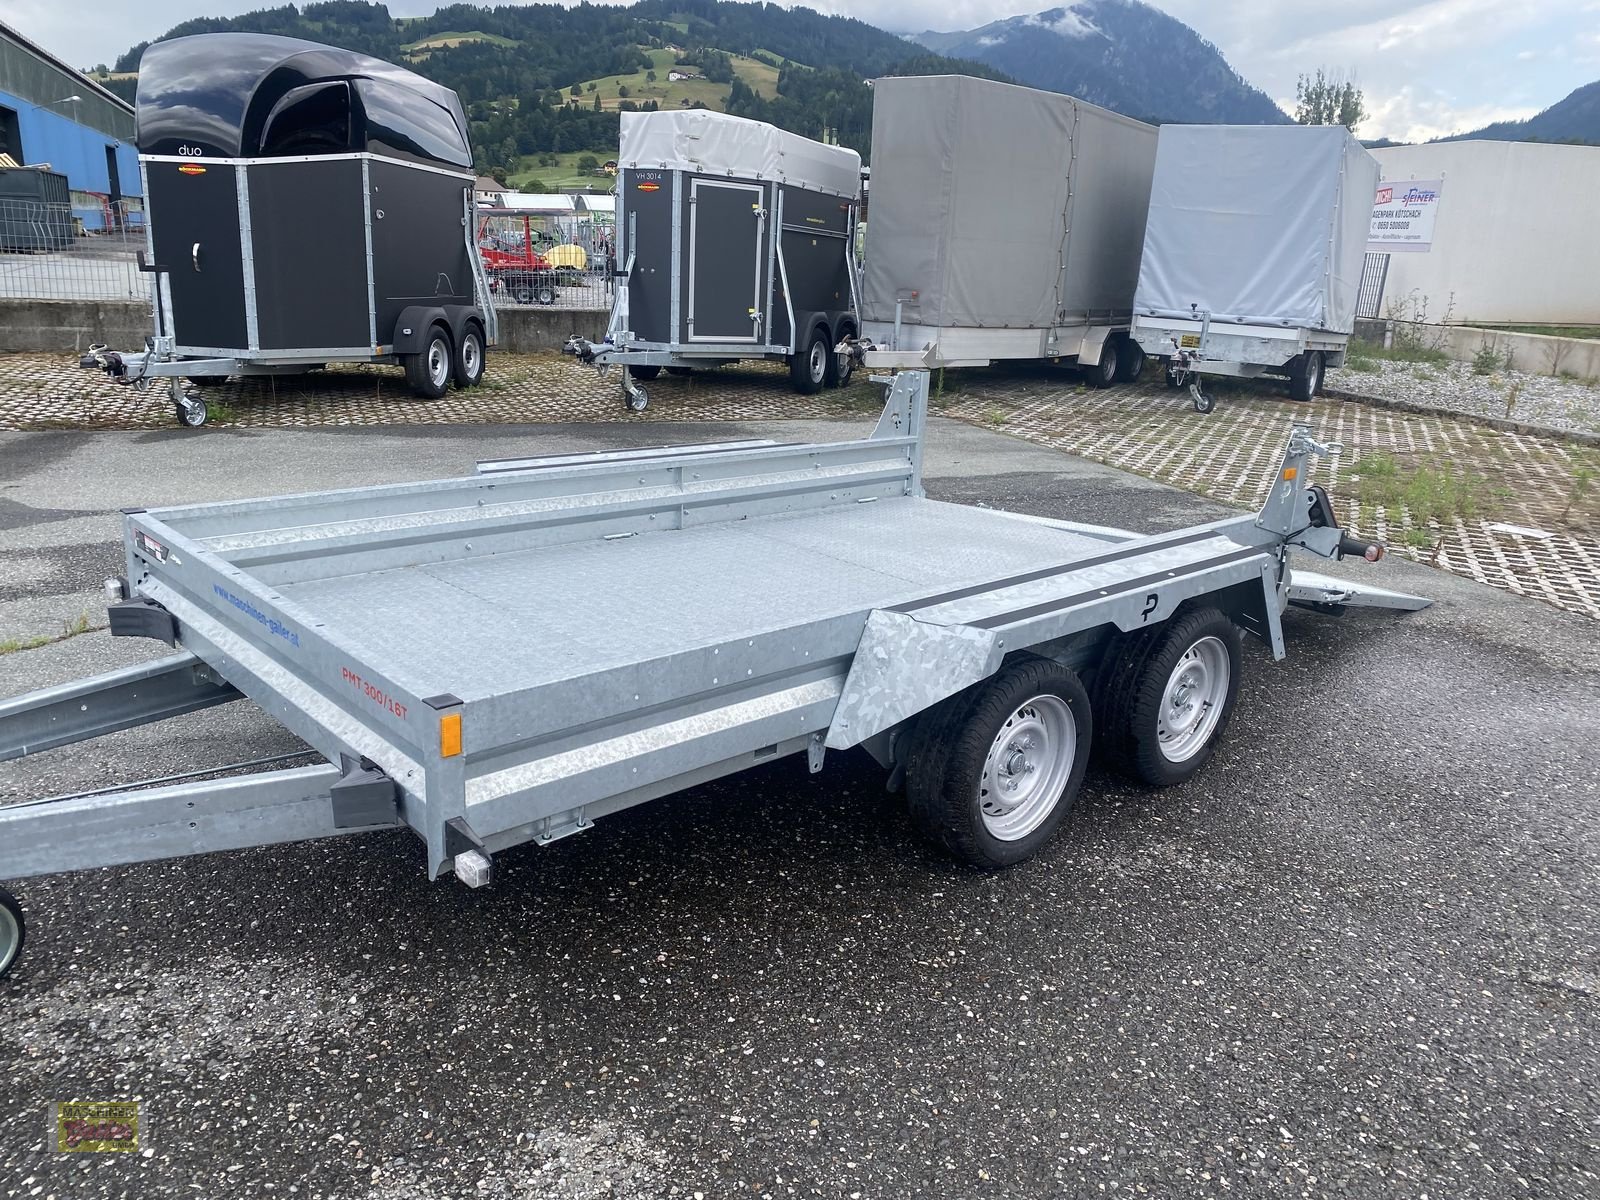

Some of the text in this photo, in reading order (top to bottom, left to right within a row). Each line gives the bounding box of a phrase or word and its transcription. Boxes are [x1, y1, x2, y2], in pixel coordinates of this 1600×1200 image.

[178, 144, 202, 156] duo
[646, 172, 662, 180] 3014
[213, 584, 300, 648] www.maschinen-gailer.at
[342, 667, 408, 721] PMT 300/16T
